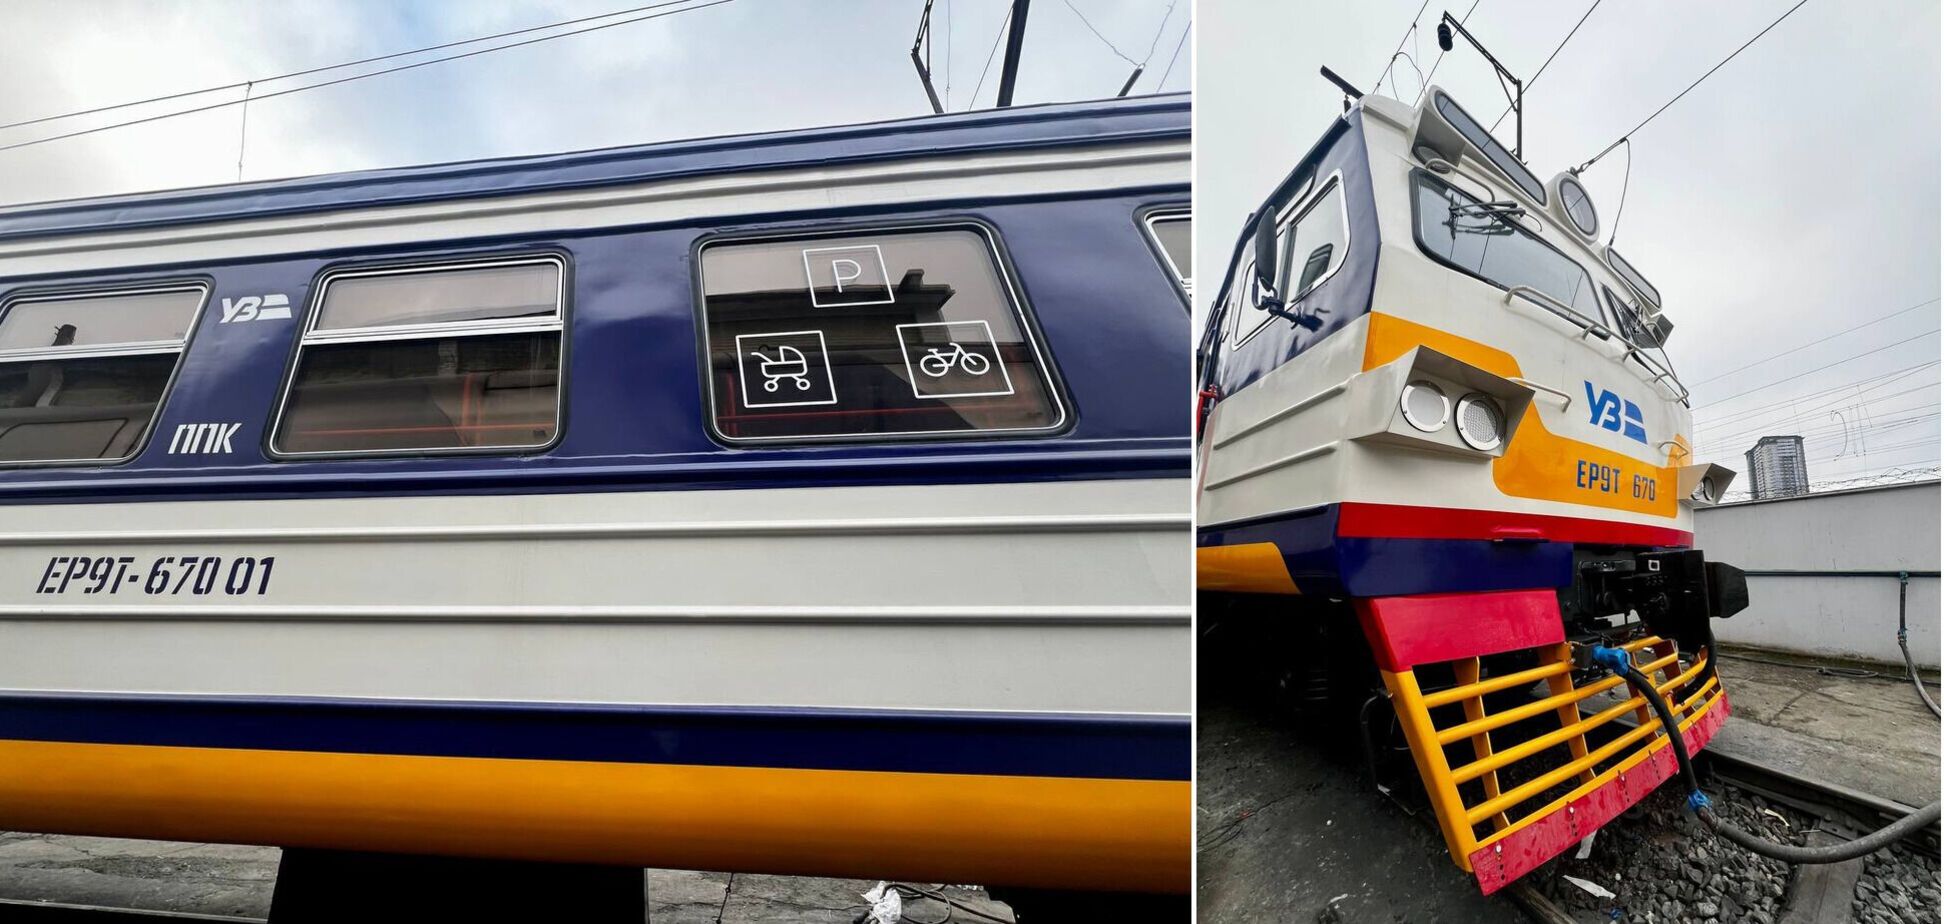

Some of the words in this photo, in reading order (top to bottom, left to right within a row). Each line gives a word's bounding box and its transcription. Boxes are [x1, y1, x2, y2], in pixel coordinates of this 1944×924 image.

[832, 259, 861, 293] P
[168, 423, 242, 454] ППК
[1633, 474, 1656, 501] 670
[225, 557, 275, 595] 01
